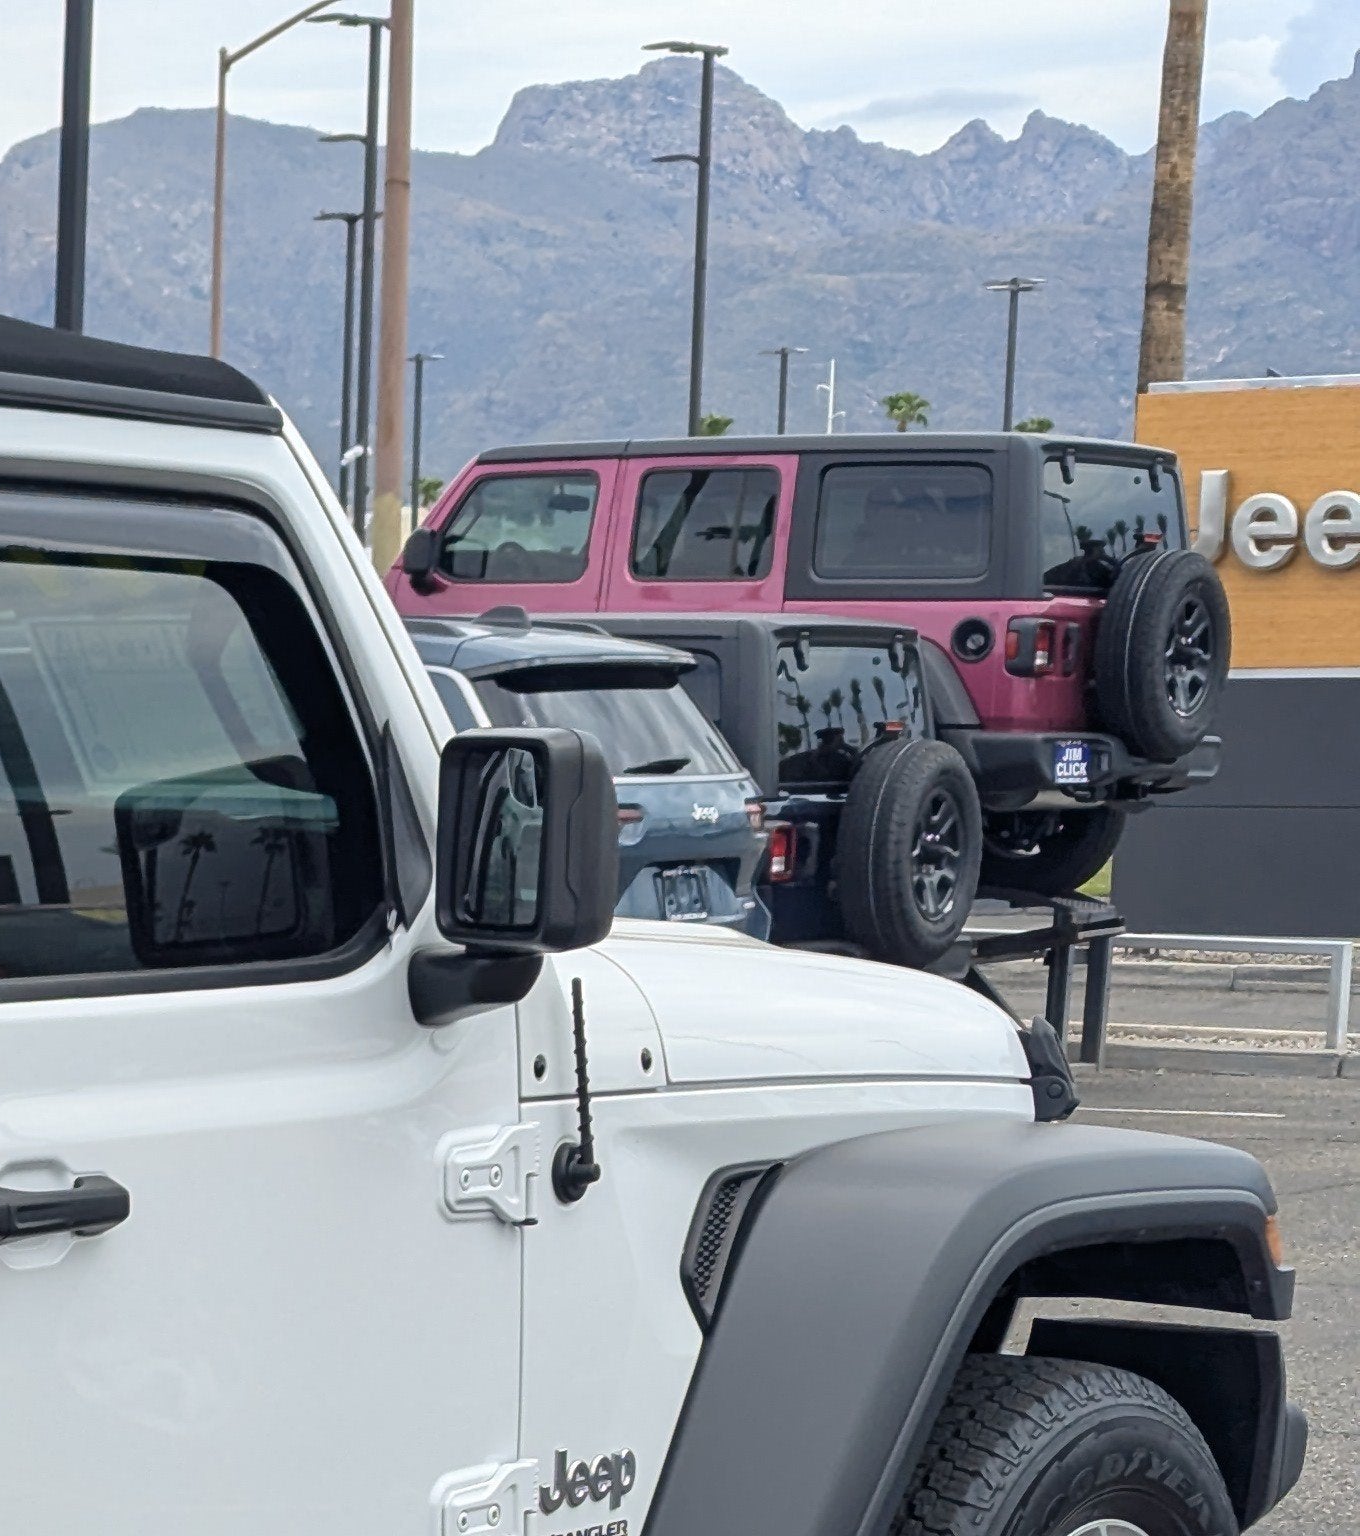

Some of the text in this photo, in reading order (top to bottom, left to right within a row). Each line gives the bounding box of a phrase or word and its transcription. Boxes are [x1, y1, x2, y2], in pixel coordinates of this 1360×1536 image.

[1062, 747, 1083, 761] JIM
[1056, 762, 1088, 776] CLICK
[538, 1447, 637, 1516] Jeep
